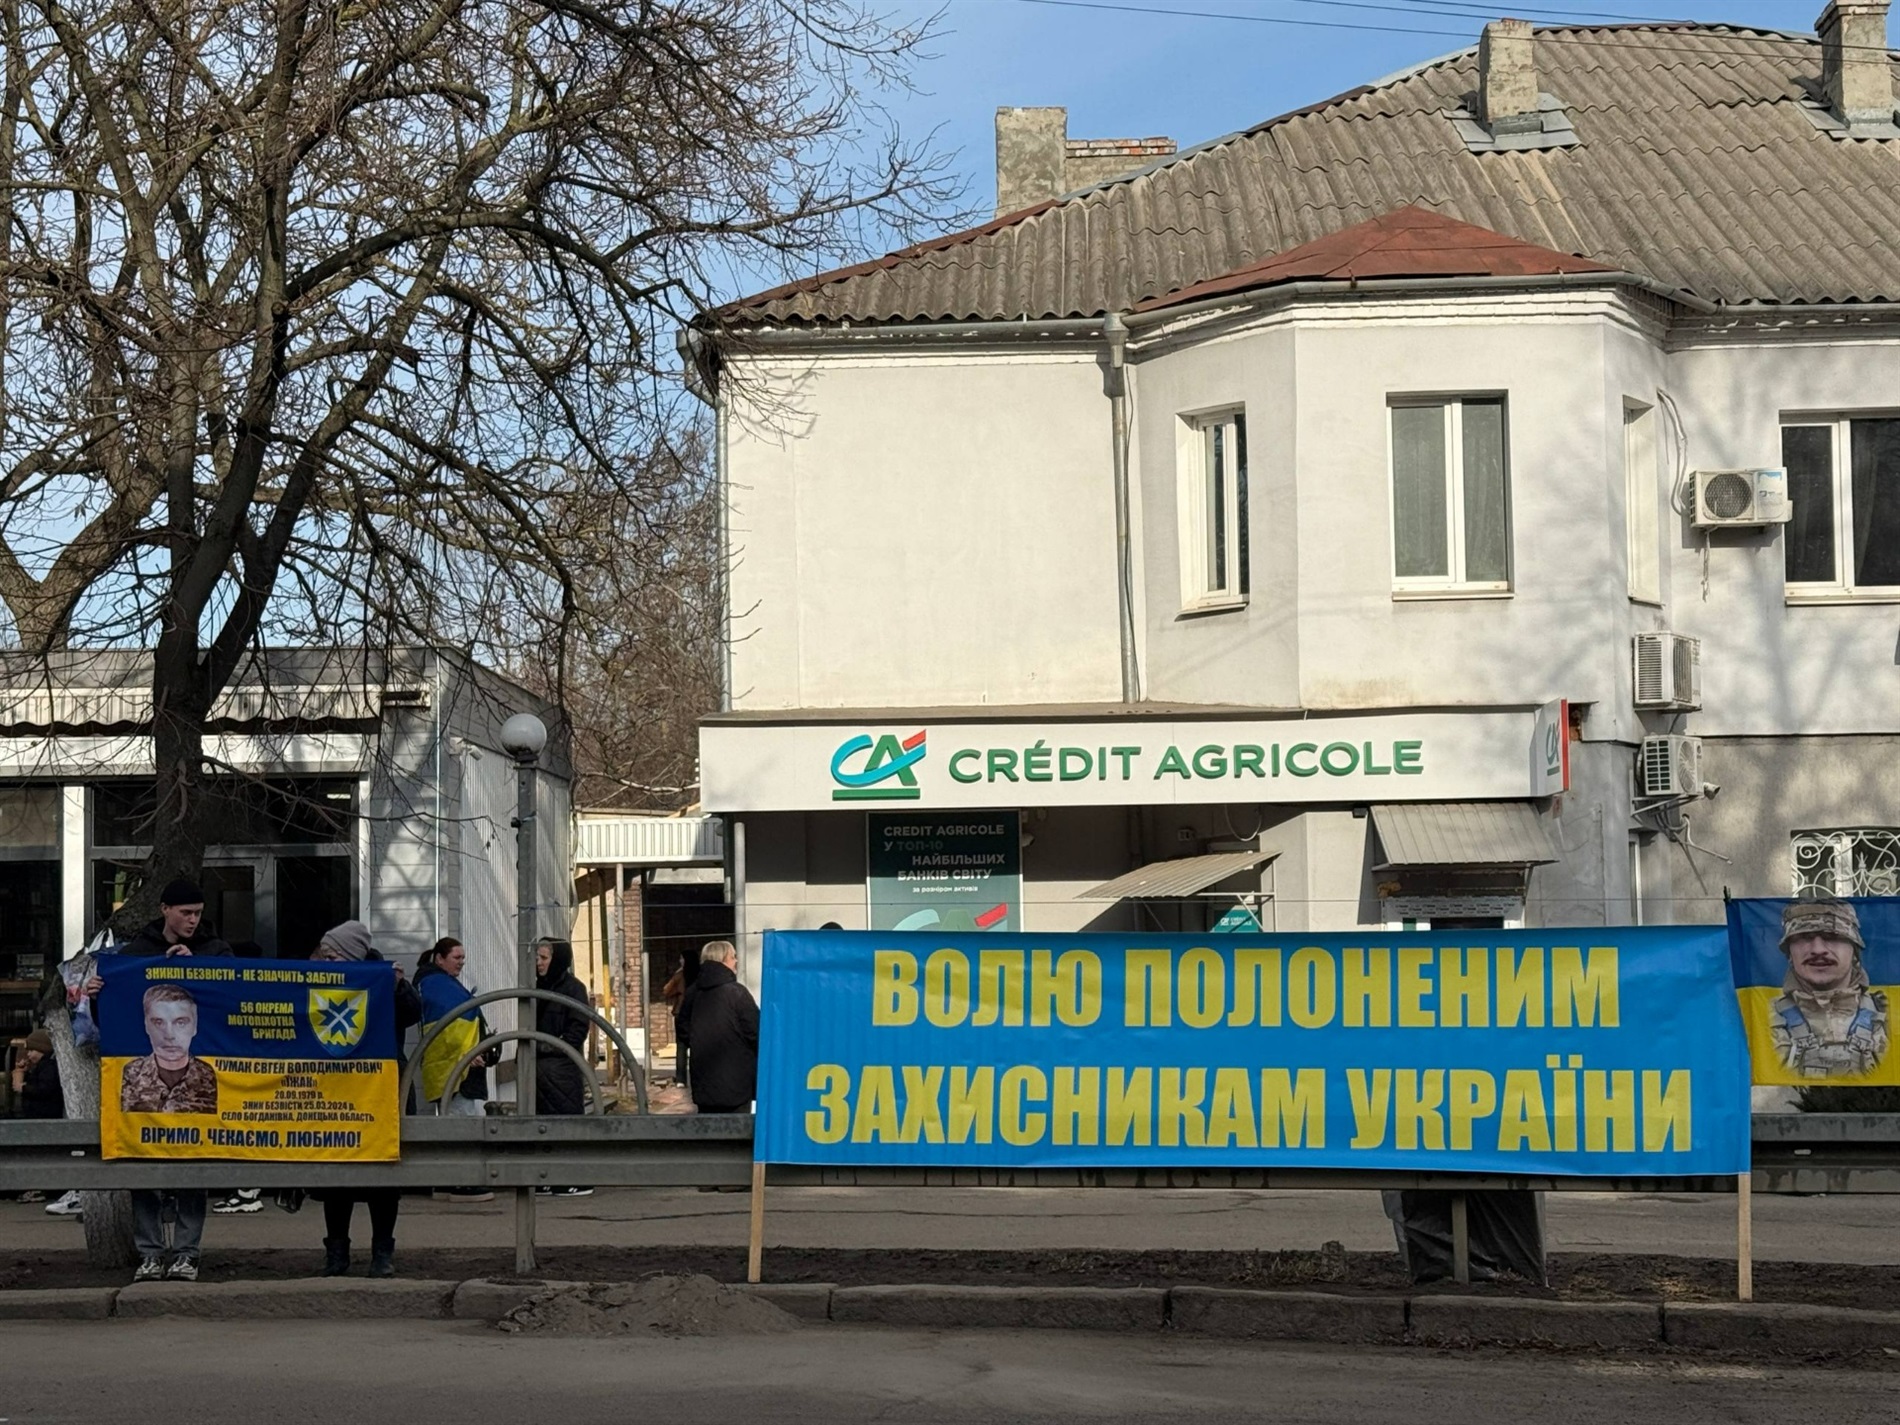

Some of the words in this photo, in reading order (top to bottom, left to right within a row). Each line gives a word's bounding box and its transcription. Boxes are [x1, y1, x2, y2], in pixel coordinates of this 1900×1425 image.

[948, 740, 1141, 783] CRÉDIT
[1154, 739, 1424, 780] AGRICOLE
[884, 826, 932, 836] CREDIT
[937, 825, 1004, 836] AGRICOLE
[884, 841, 893, 851] У
[897, 841, 943, 850] ТОП-10
[912, 853, 1004, 865] НАЙБІЛЬШИХ
[897, 869, 949, 881] БАНКІВ
[952, 869, 991, 880] СВІТУ
[145, 968, 185, 981] ЗНИКЛІ
[186, 968, 235, 981] БЕЗВІСТИ
[243, 969, 256, 982] НЕ
[257, 970, 304, 983] ЗНАЧИТЬ
[872, 948, 1102, 1028] ВОЛЮ
[1124, 947, 1620, 1028] ПОЛОНЕНИМ
[240, 1002, 254, 1013] 56
[255, 1002, 294, 1014] ОКРЕМА
[228, 1015, 295, 1027] МОТОПІХОТНА
[252, 1028, 296, 1040] БРИГАДА
[253, 1061, 285, 1074] ЄВГЕН
[287, 1061, 383, 1075] ВОЛОДИМИРОВИЧ
[265, 1101, 302, 1110] БЕЗВІСТИ
[805, 1064, 1325, 1148] ЗАХИСНИКАМ
[1346, 1054, 1692, 1152] УКРАЇНИ
[221, 1112, 242, 1121] СЕЛО
[296, 1112, 338, 1122] ДОНЕЦЬКА
[339, 1113, 375, 1122] ОБЛАСТЬ
[141, 1127, 203, 1146] ВІРИМО,
[207, 1128, 283, 1149] ЧЕКАЄМО,
[285, 1130, 362, 1148] ЛЮБИМО!
